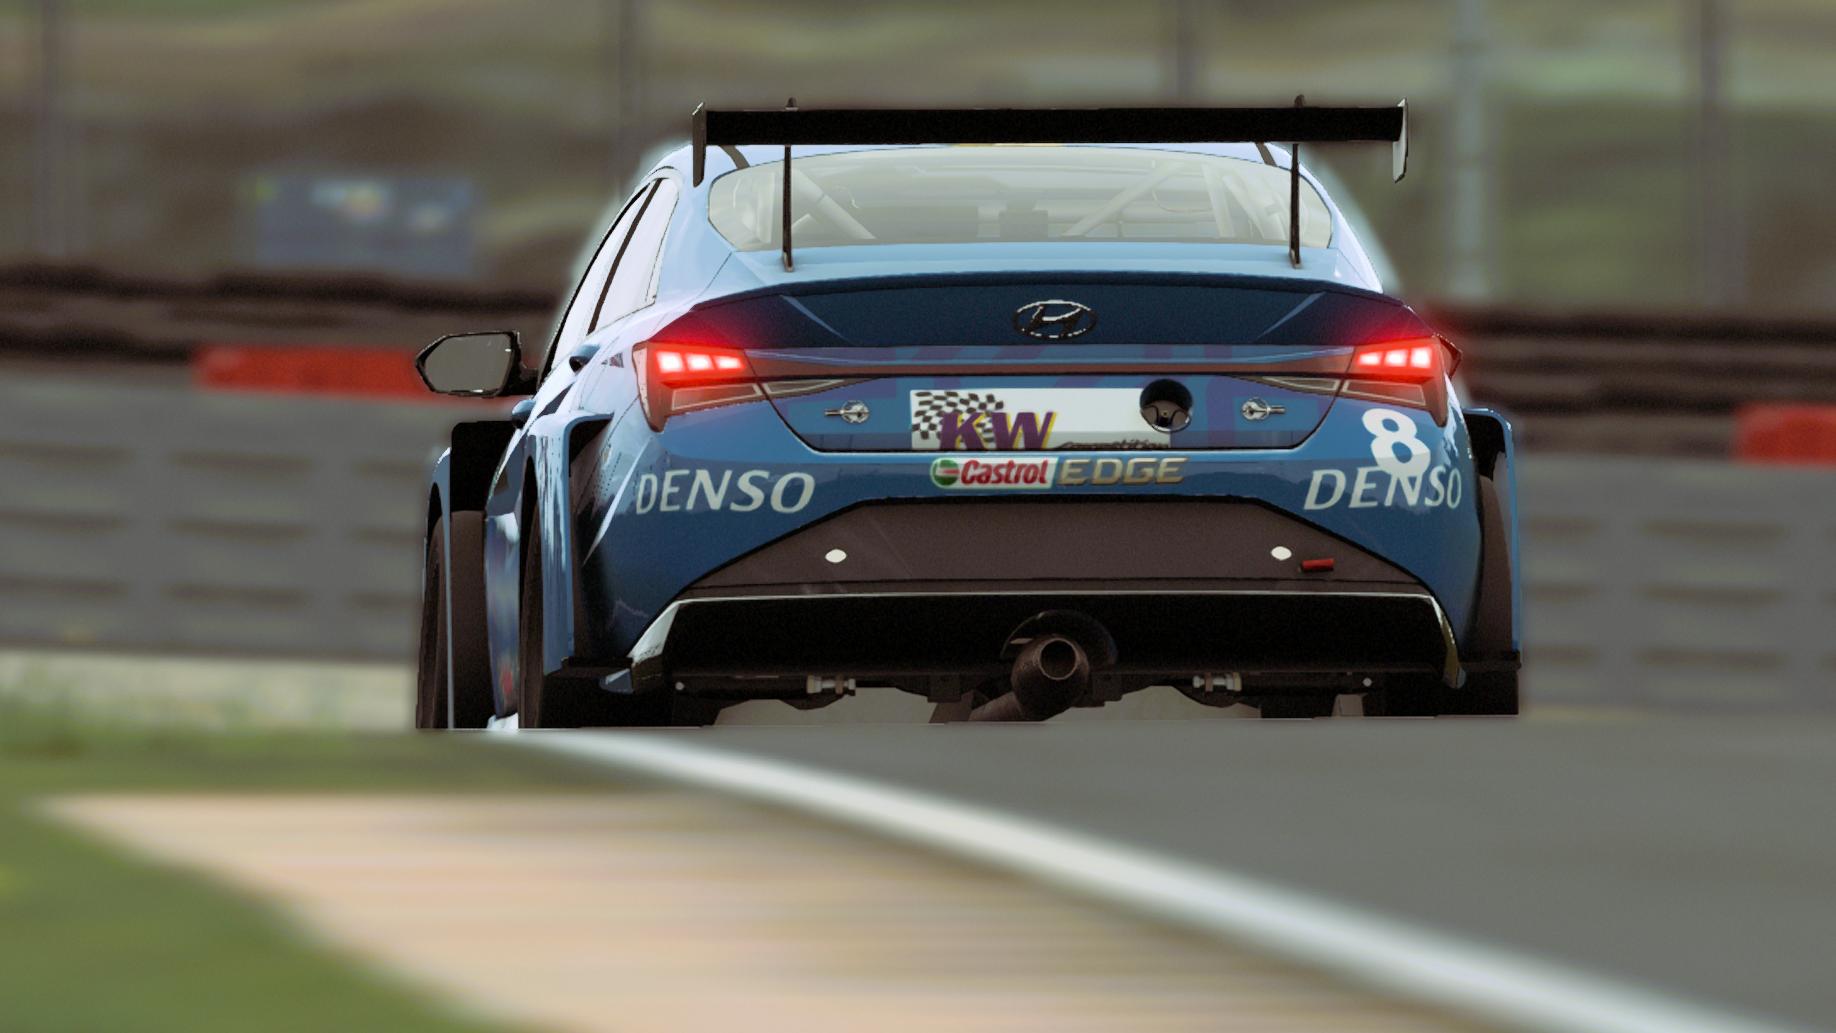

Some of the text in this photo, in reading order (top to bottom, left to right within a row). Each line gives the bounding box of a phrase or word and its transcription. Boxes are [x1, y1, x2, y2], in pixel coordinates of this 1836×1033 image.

[939, 411, 1056, 450] KW
[1362, 408, 1431, 478] 8
[636, 468, 815, 515] DENSO
[961, 457, 1188, 485] Castrol EDGE
[1303, 464, 1462, 510] DENSO
